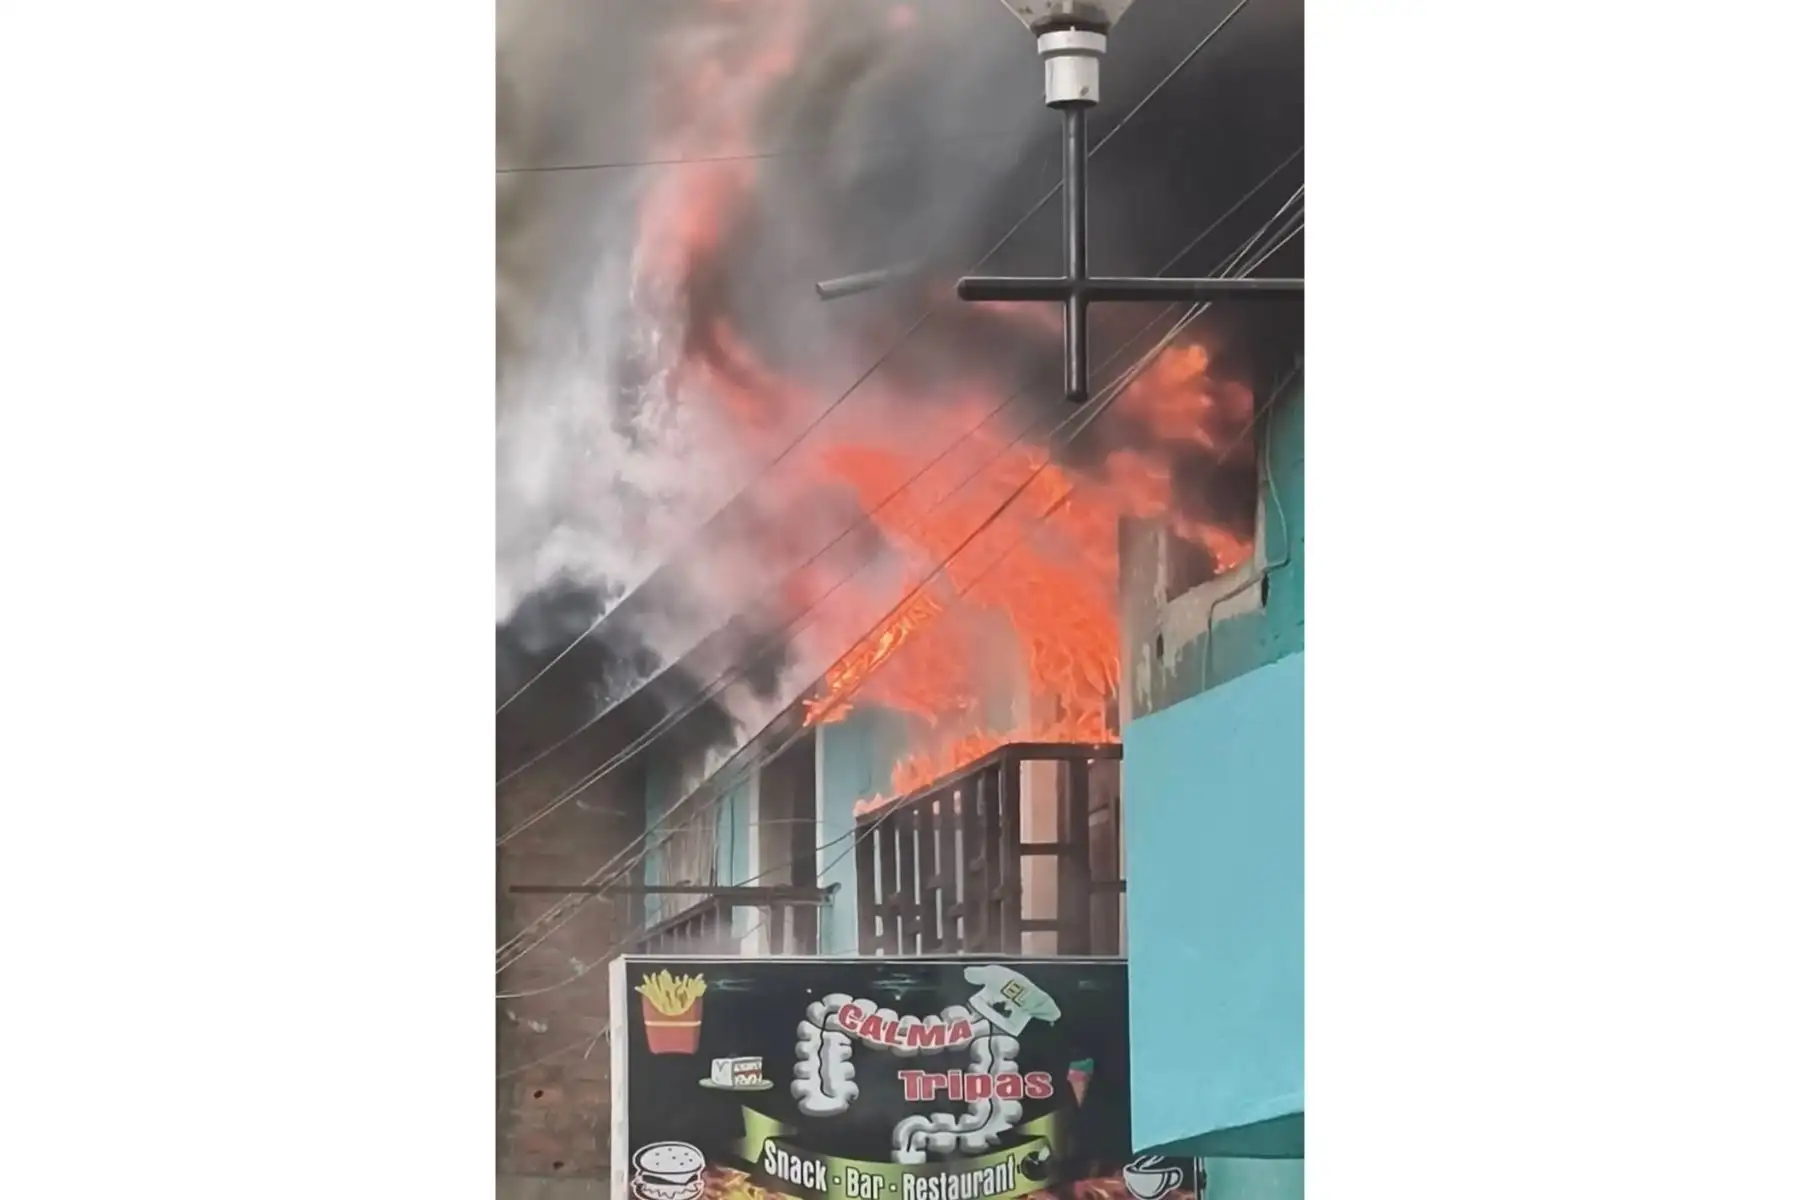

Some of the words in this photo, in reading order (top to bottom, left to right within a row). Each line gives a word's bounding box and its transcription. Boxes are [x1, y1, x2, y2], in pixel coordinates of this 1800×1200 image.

[837, 1003, 973, 1048] CALMA
[898, 1070, 1053, 1102] Tripas
[764, 1139, 827, 1192] Snack
[846, 1166, 884, 1200] Bar
[902, 1154, 1015, 1200] Restaurant
